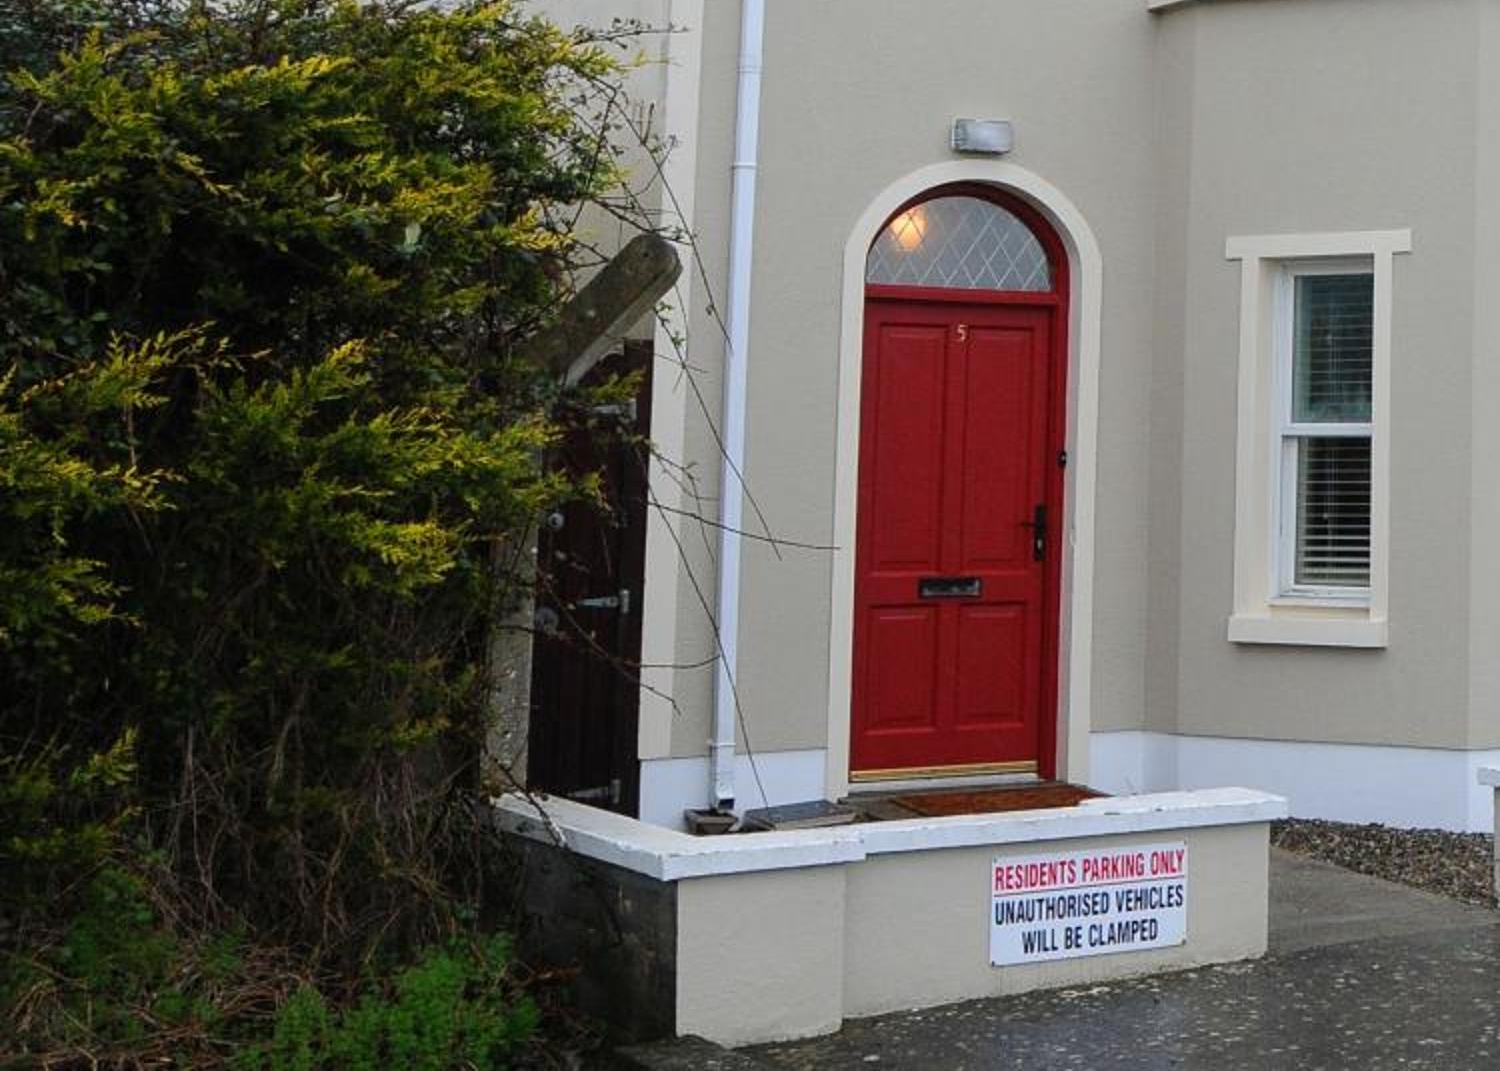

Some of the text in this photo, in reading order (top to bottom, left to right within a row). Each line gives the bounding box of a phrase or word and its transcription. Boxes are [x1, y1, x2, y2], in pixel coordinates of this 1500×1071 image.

[956, 325, 968, 343] 5
[994, 848, 1185, 890] RESIDENTS PARKING ONLY
[994, 884, 1184, 926] UNAUTHORISED VEHICLES
[1022, 917, 1158, 954] WILL BE CLAMPED
